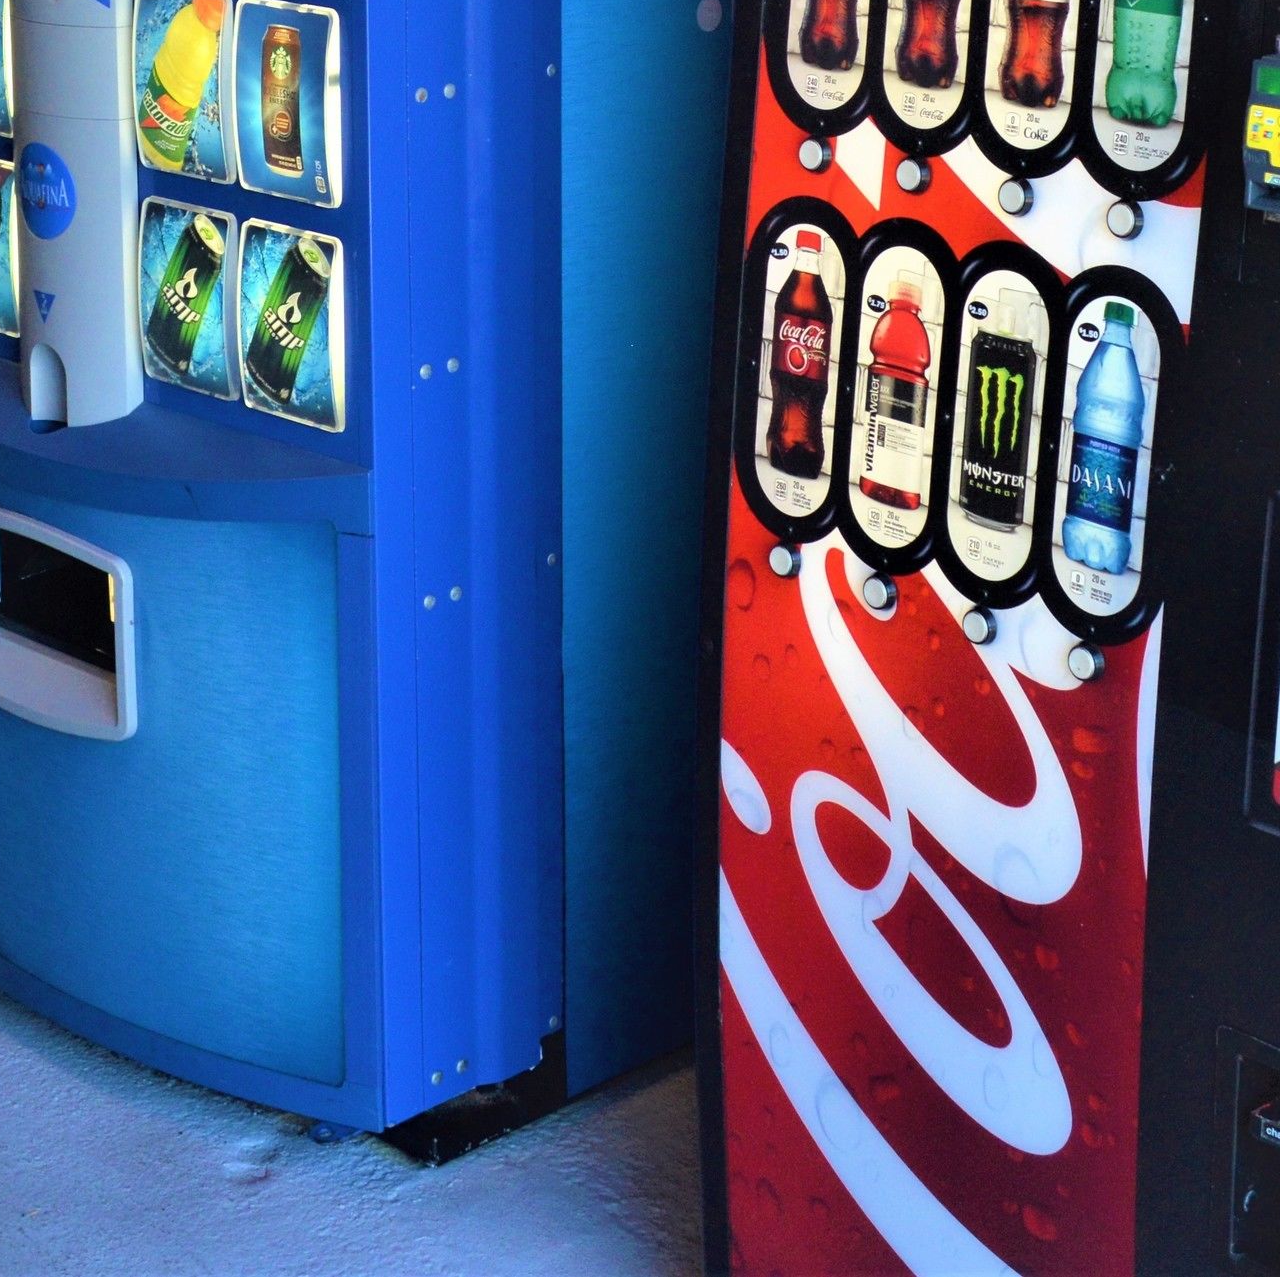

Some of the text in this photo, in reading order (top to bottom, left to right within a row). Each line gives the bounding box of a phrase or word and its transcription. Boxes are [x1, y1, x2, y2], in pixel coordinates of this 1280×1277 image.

[824, 75, 832, 84] 20
[922, 93, 930, 102] 20
[1026, 113, 1034, 122] 20
[1023, 126, 1048, 141] Coke
[1115, 133, 1128, 144] 240
[1135, 132, 1144, 141] 20
[771, 249, 788, 257] $1.50
[868, 297, 885, 309] $1.75
[969, 306, 988, 317] $2.50
[779, 319, 826, 350] Coca-Cola
[1079, 328, 1099, 338] $1.50
[865, 376, 881, 472] vitaminwater
[963, 459, 1025, 489] MONSTER
[793, 480, 800, 490] 20
[1072, 464, 1132, 499] DASANI
[969, 480, 1018, 498] ENERGY
[887, 510, 895, 520] 20
[1091, 573, 1100, 584] 20
